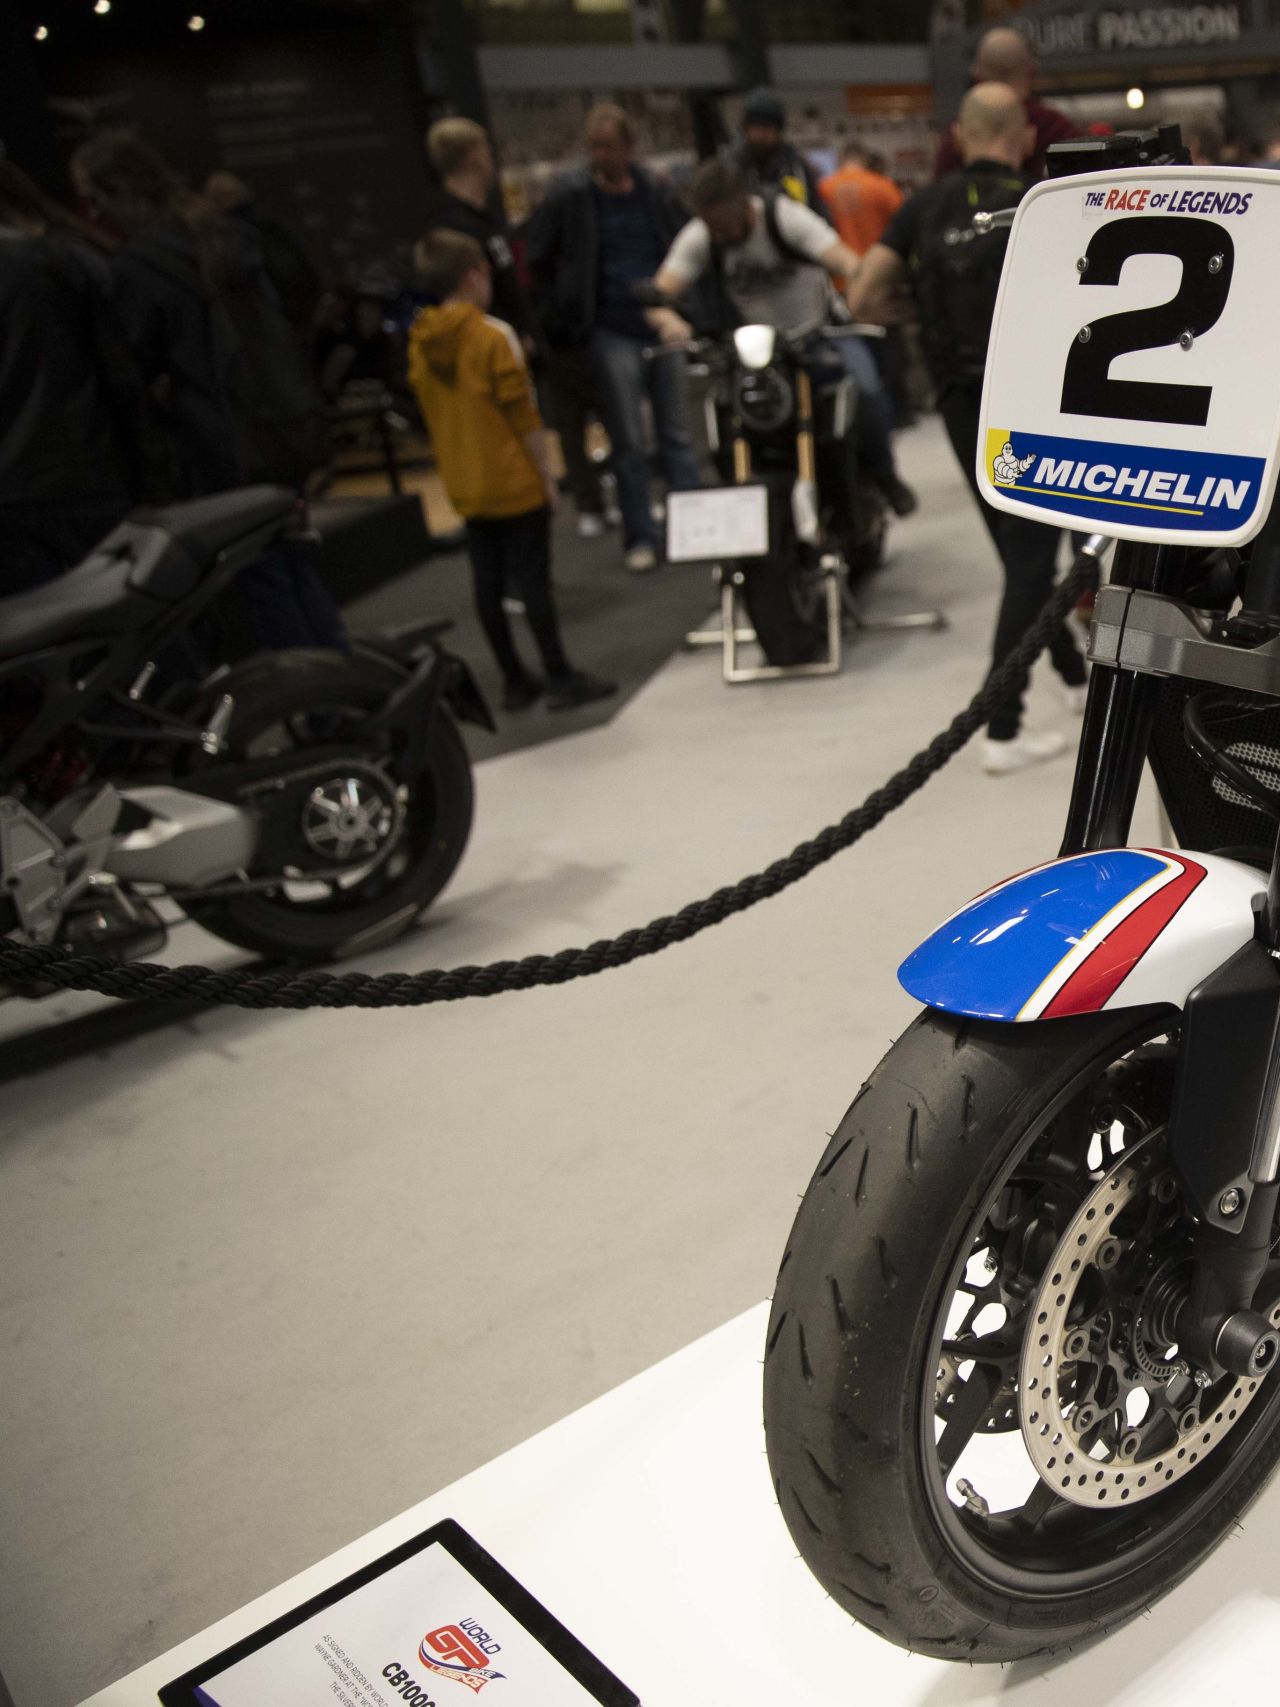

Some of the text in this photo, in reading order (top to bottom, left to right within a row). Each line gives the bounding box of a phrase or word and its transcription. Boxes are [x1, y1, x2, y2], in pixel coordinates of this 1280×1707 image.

[1098, 5, 1241, 50] PASSION
[1085, 189, 1253, 215] THE RACE OF LEGENDS
[1060, 216, 1234, 426] 2
[1032, 457, 1251, 510] MICHELIN
[459, 1617, 502, 1655] WORLD
[327, 1659, 350, 1682] GARDNER
[344, 1680, 355, 1689] AT
[330, 1681, 342, 1694] THE
[342, 1657, 354, 1669] AND
[350, 1667, 369, 1686] RIDDEN
[364, 1683, 375, 1693] BY
[431, 1665, 486, 1689] LEGENDS
